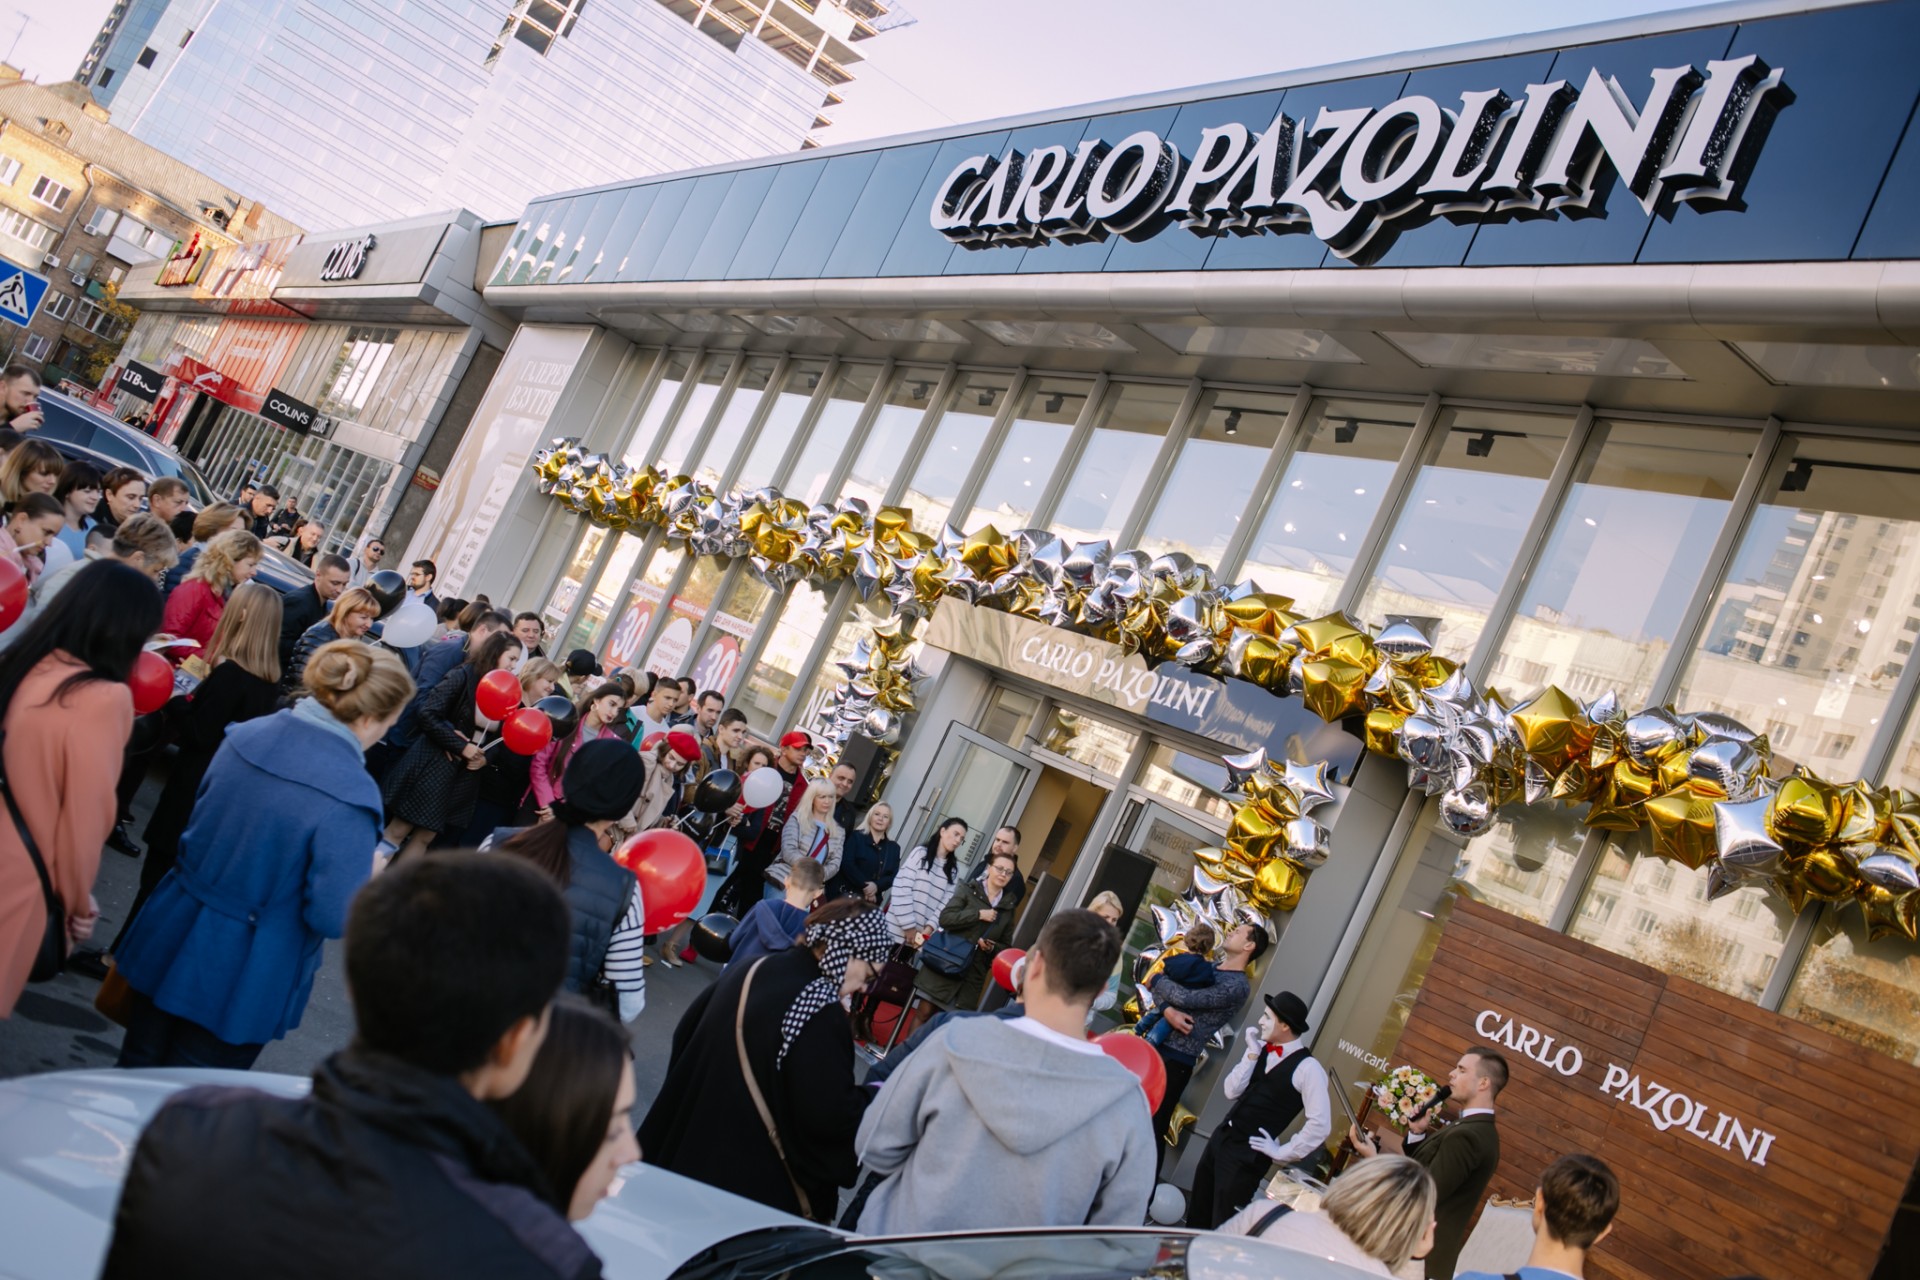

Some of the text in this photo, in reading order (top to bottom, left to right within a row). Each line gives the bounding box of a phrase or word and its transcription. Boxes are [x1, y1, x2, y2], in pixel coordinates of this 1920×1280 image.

[930, 53, 1792, 264] CARLO PAZOLINI
[269, 399, 310, 425] COLIN'S
[1022, 636, 1215, 718] CARLO PAZOLINI
[1475, 1009, 1776, 1167] CARLO PAZOLINI
